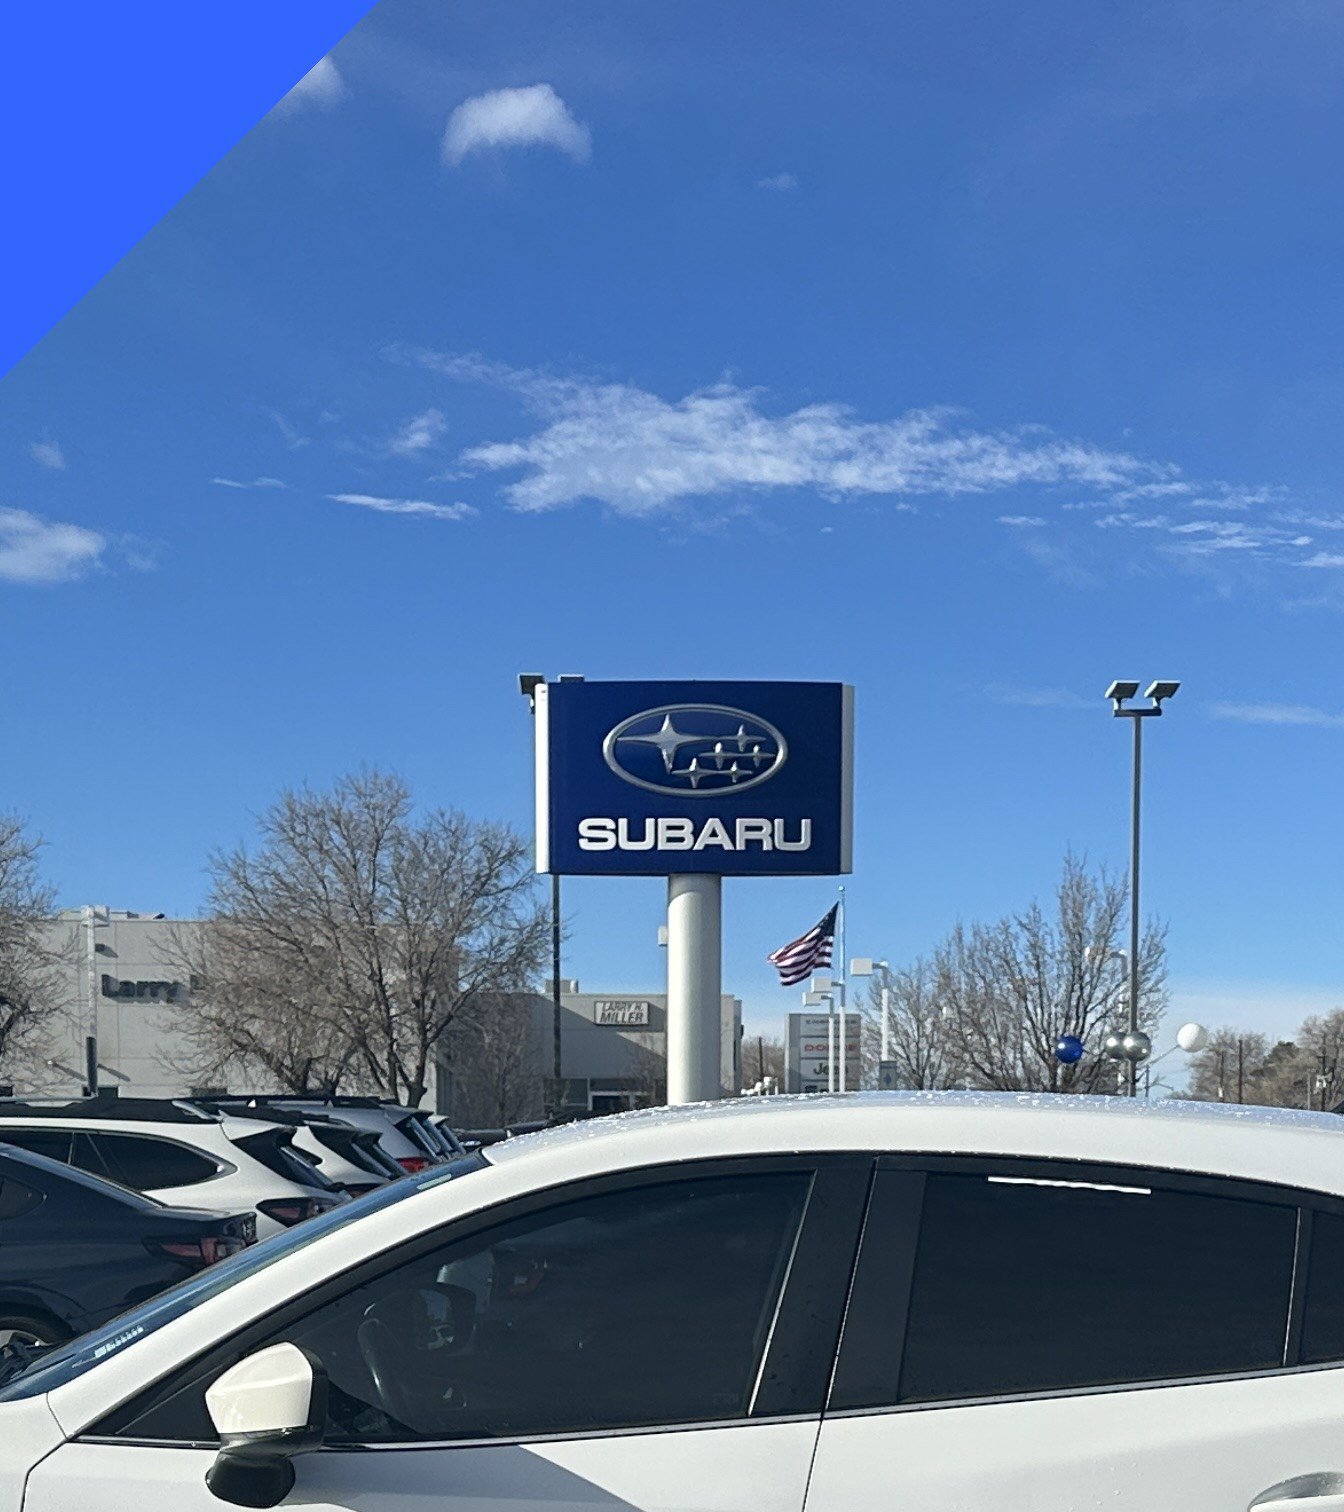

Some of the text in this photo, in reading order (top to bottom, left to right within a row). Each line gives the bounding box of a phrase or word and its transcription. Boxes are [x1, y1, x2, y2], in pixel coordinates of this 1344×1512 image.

[577, 817, 812, 852] SUBARU
[600, 1011, 644, 1024] MILLER
[804, 1043, 857, 1052] DOE
